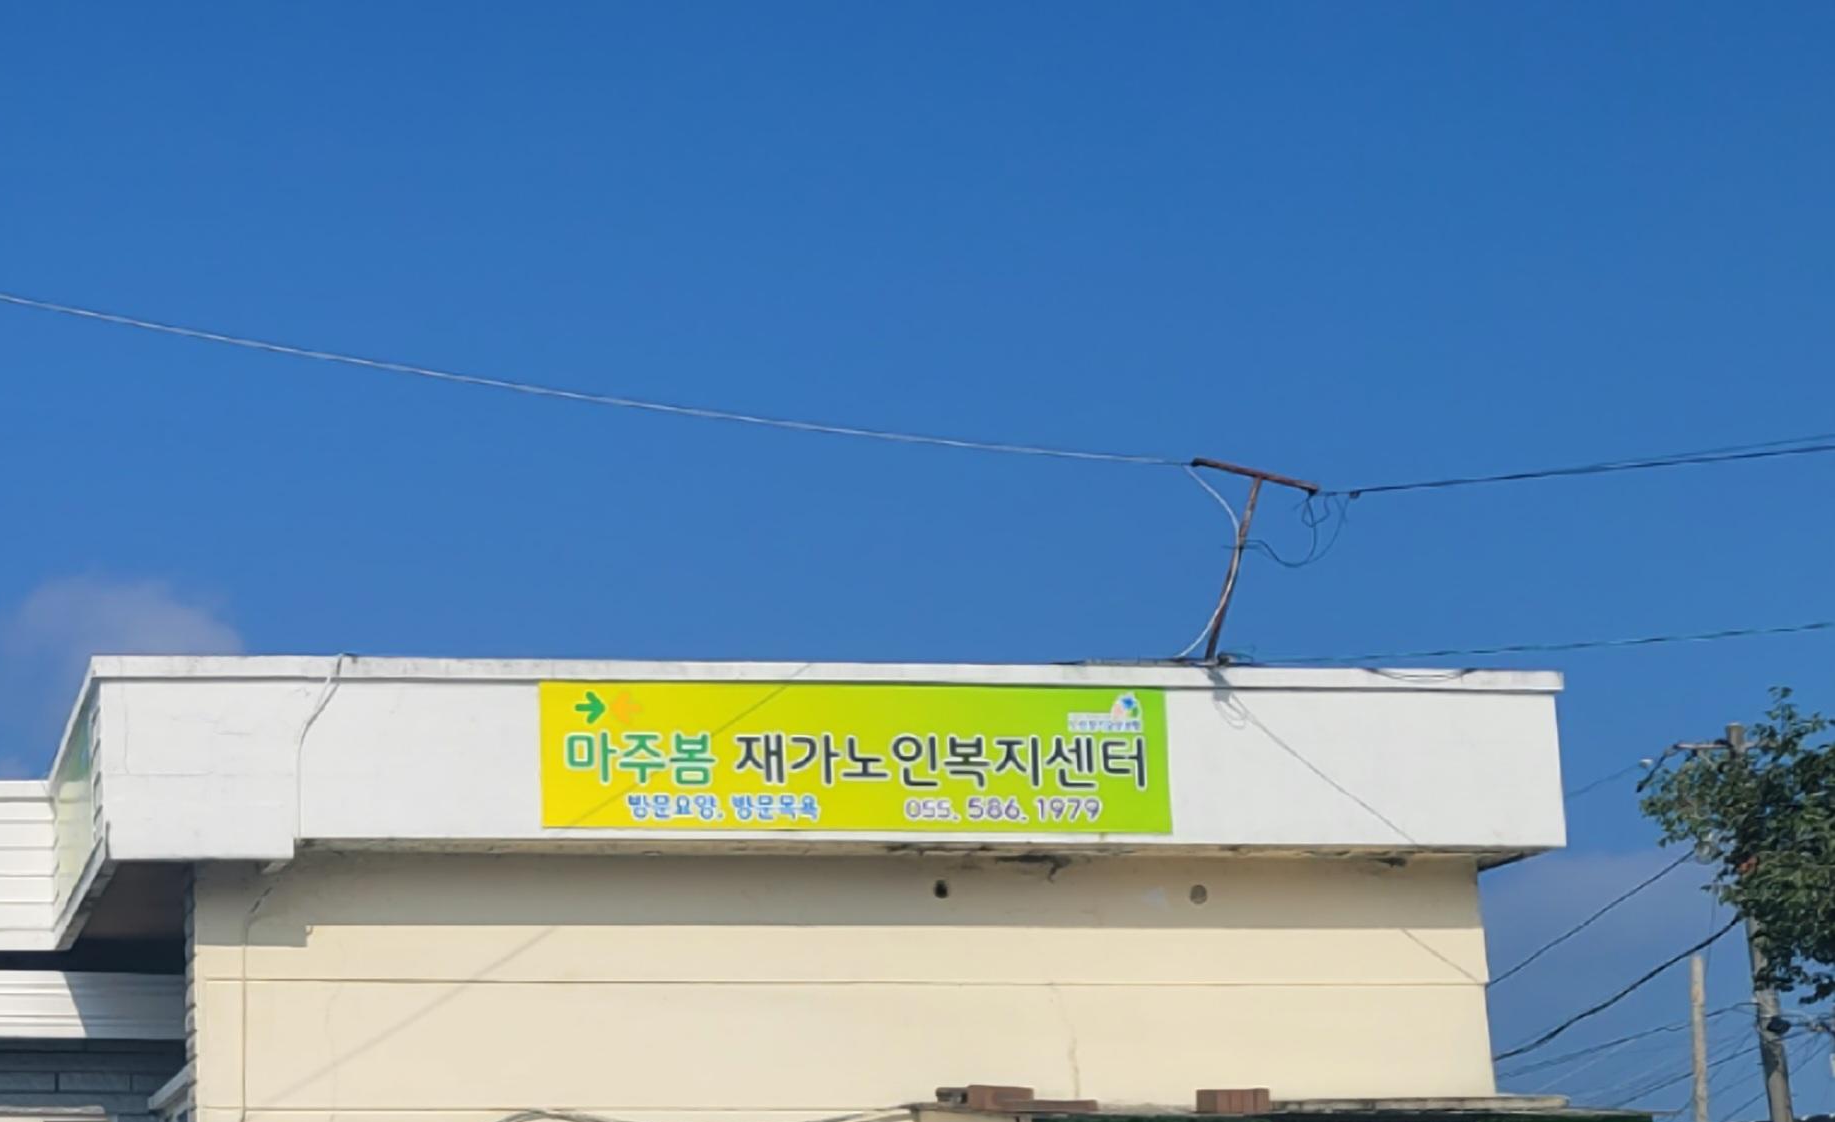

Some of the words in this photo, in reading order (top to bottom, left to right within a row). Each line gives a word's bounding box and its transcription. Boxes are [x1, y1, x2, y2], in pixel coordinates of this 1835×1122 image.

[565, 731, 717, 786] 마주봄
[734, 734, 1148, 789] 재가노인복지센터
[731, 794, 818, 820] 방문목욕
[1036, 797, 1101, 821] 1979
